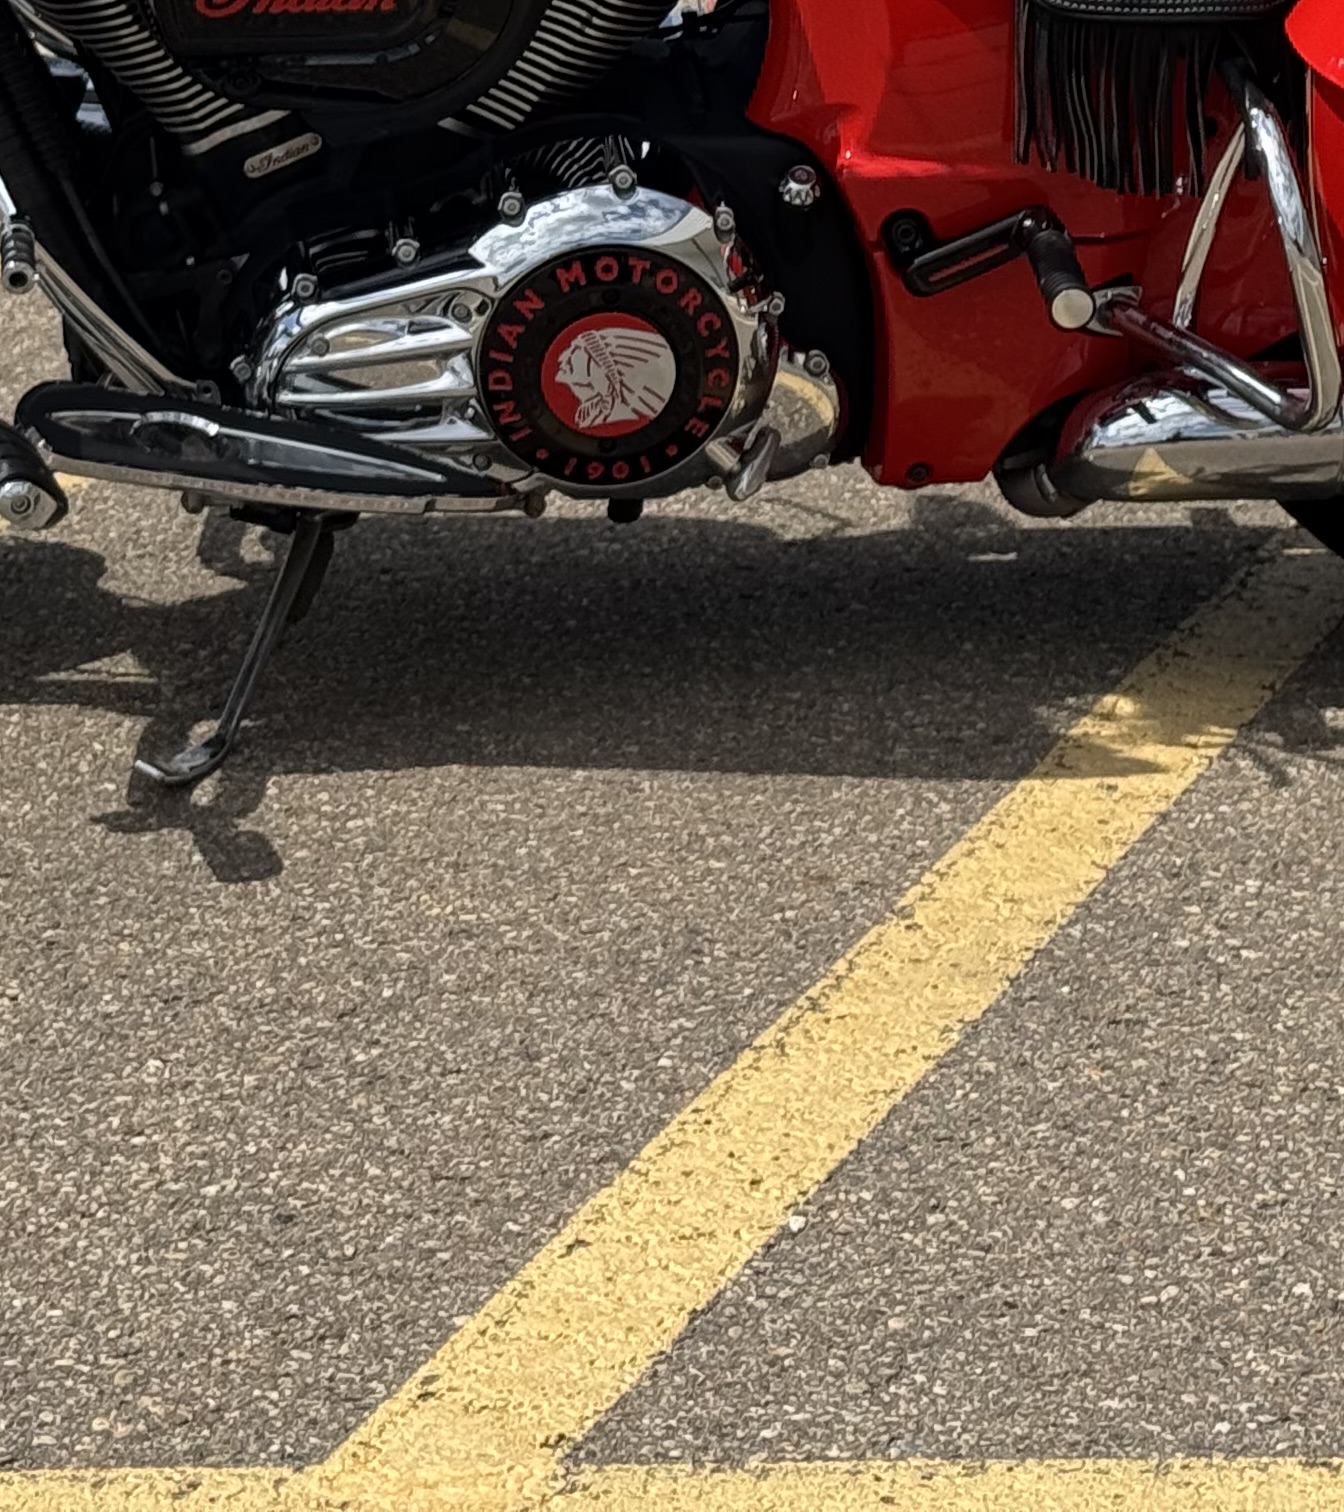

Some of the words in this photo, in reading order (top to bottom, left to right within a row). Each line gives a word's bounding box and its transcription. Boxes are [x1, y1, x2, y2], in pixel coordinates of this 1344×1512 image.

[256, 142, 310, 173] Indian
[488, 289, 545, 442] INDIAN
[556, 255, 731, 438] MOTORCYCLE
[564, 455, 651, 479] 1901
